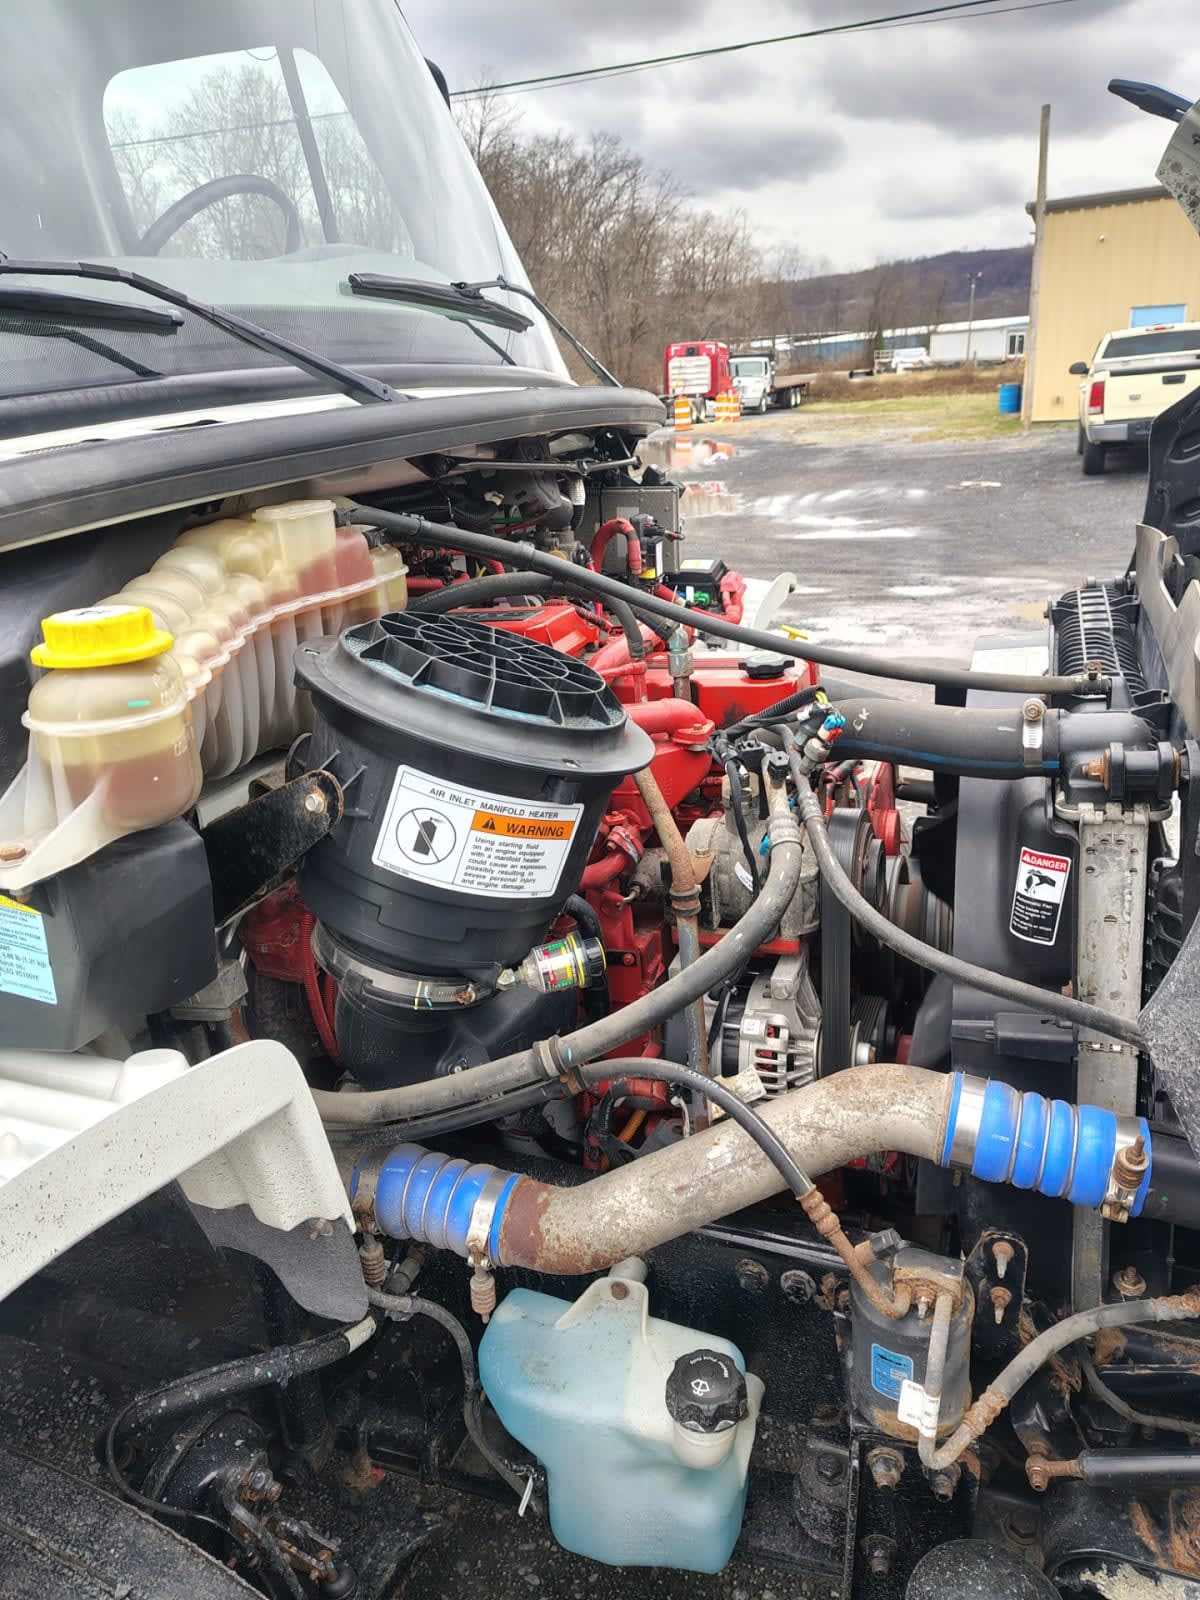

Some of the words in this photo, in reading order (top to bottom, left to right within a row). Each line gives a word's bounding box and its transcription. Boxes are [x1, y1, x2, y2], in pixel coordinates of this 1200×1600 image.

[429, 787, 446, 799] AIR
[449, 793, 477, 807] INLET
[480, 802, 525, 816] MANIFOLD
[529, 810, 559, 819] HEATER
[506, 823, 564, 837] WARNING
[475, 836, 495, 846] Using
[498, 841, 523, 850] starting
[494, 855, 521, 863] manifold
[1029, 855, 1067, 870] DANGER
[465, 865, 495, 874] possibly
[498, 869, 525, 877] resulting
[476, 881, 498, 889] engine
[489, 875, 518, 883] personal
